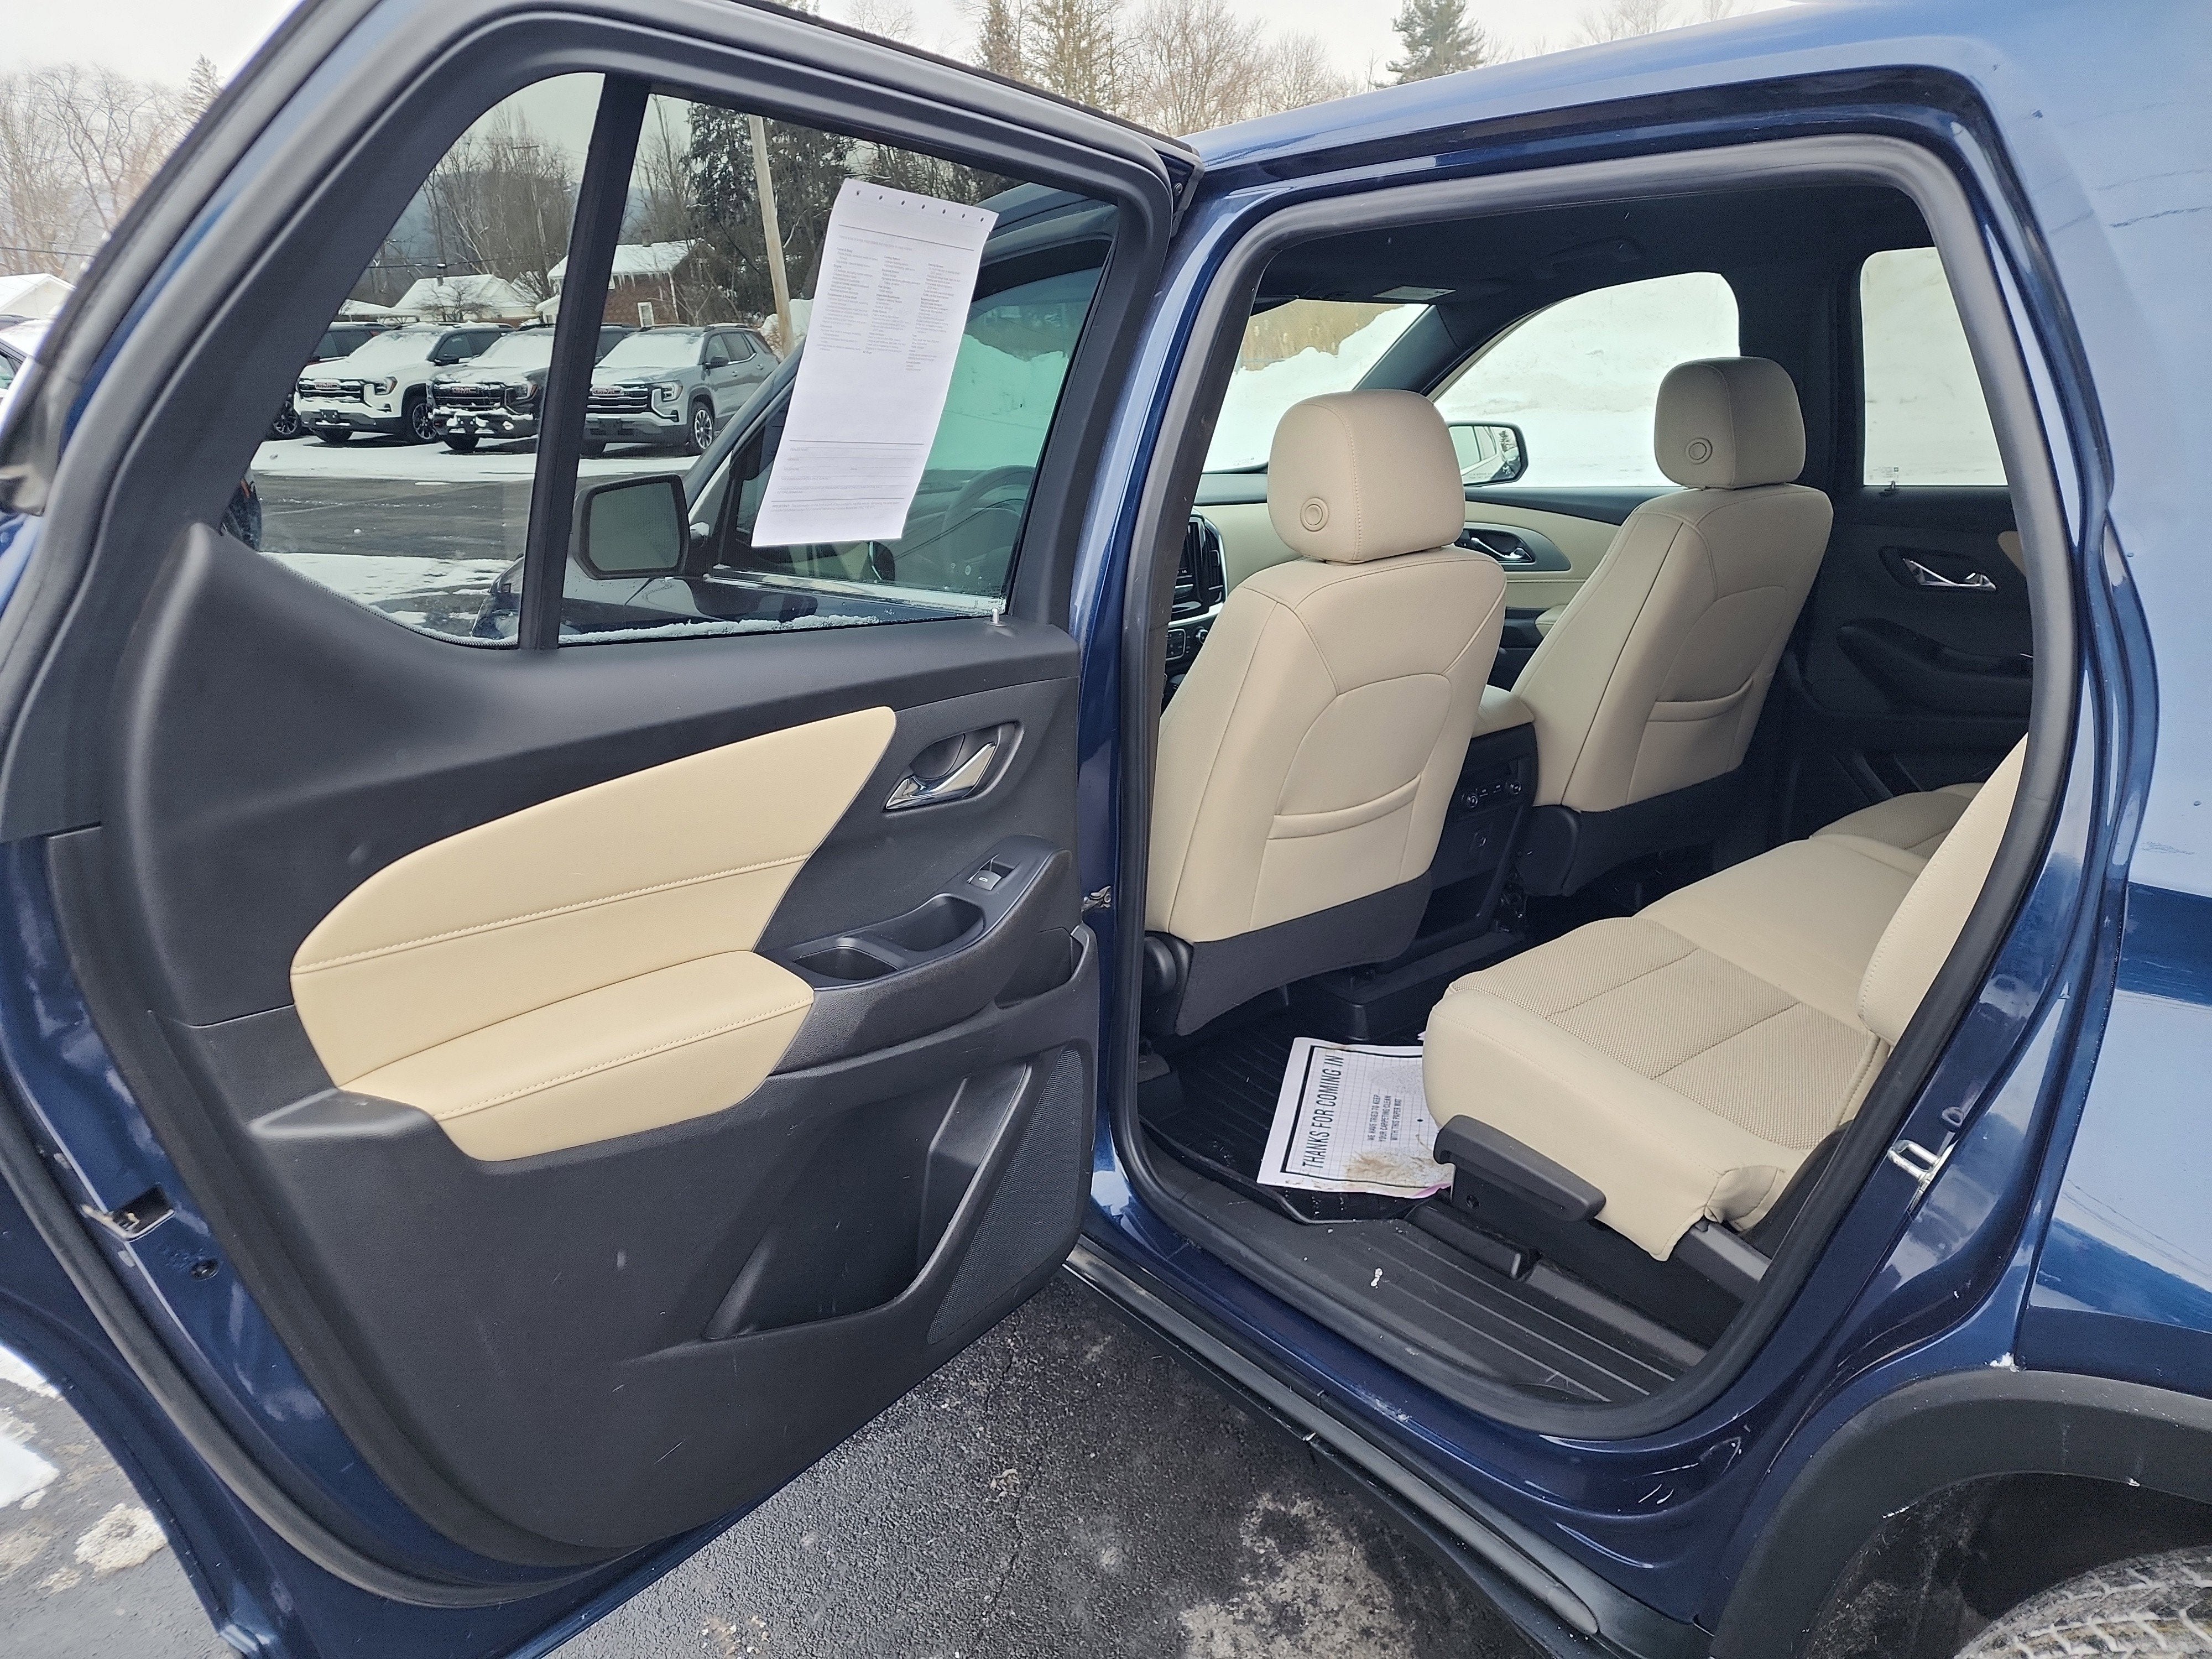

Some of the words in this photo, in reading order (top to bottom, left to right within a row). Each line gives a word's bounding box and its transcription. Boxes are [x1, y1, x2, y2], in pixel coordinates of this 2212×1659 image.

[1324, 1055, 1344, 1067] IN
[1316, 1068, 1341, 1107] COMING
[1383, 1095, 1391, 1108] CLEAN
[1311, 1109, 1334, 1128] FOR
[1370, 1110, 1379, 1122] TRIED
[1380, 1109, 1390, 1130] CARPETING
[1369, 1123, 1378, 1133] HAVE
[1379, 1131, 1387, 1141] YOUR
[1302, 1131, 1329, 1168] THANKS
